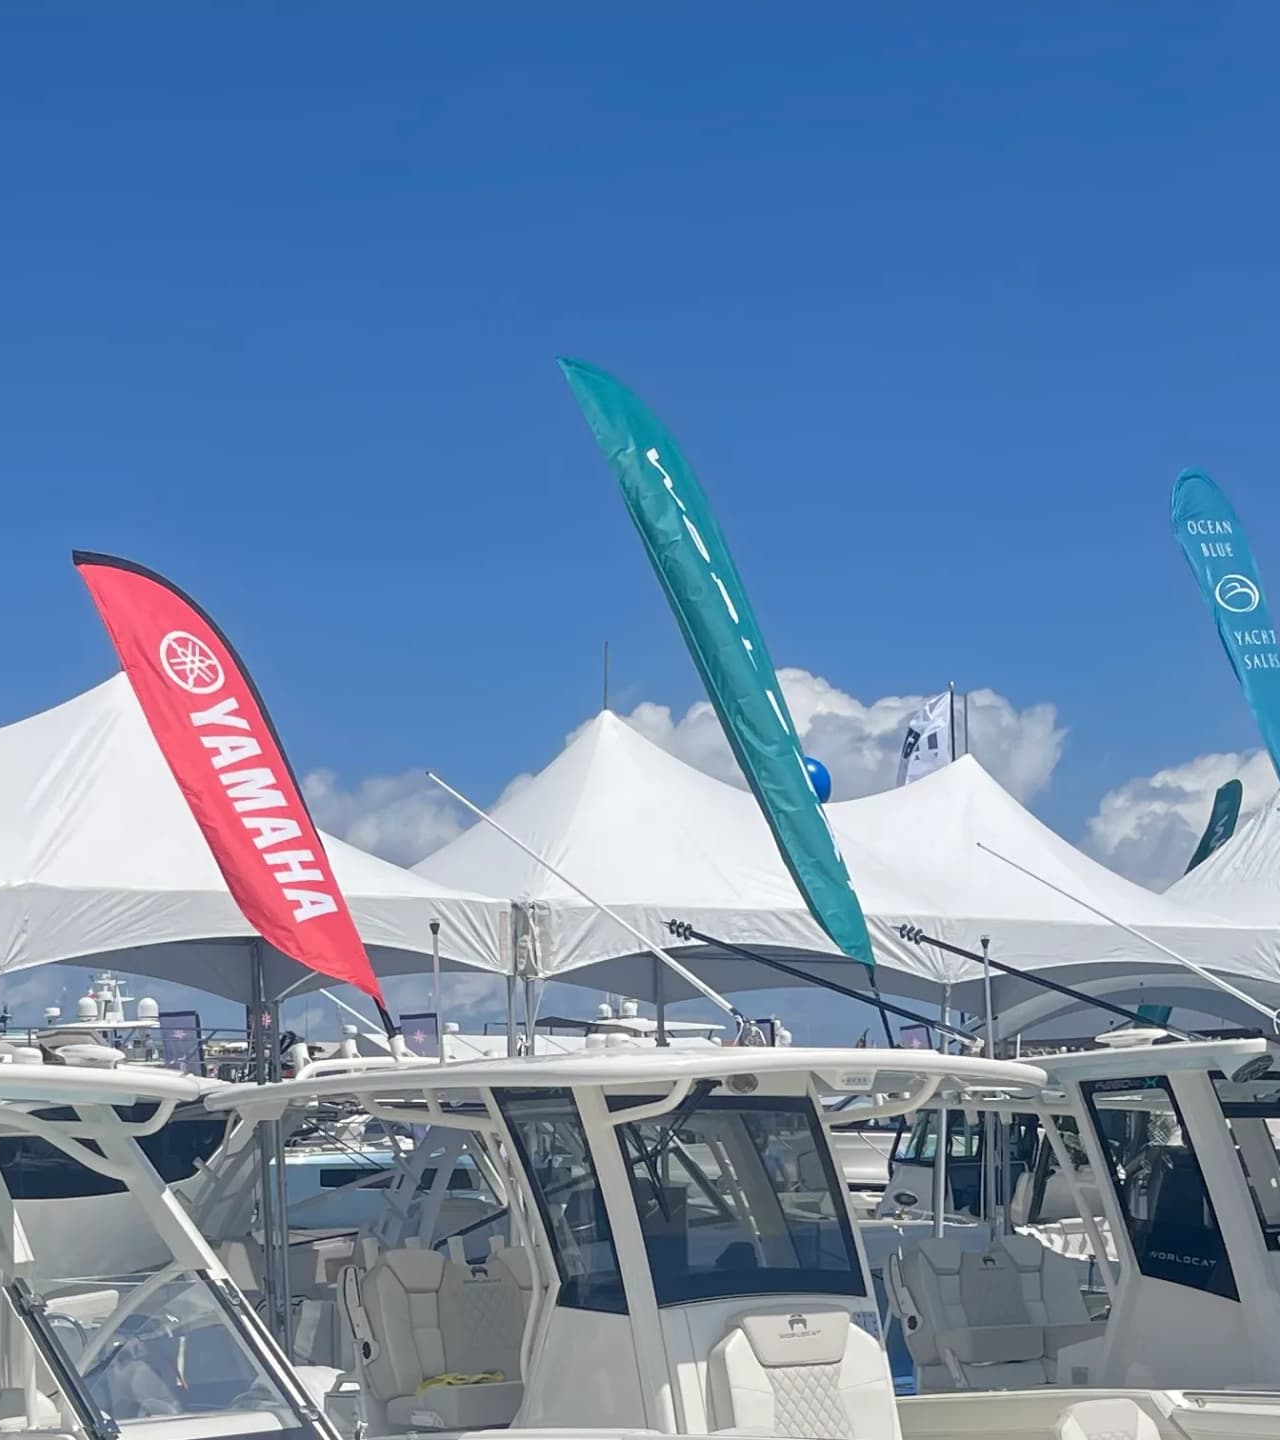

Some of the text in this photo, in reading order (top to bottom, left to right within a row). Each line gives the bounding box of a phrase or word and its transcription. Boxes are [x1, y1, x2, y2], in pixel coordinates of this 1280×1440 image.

[1187, 519, 1233, 535] OCEAN
[1200, 542, 1234, 557] BLUE
[1234, 629, 1277, 646] YACHT
[189, 697, 340, 923] YAMAHA
